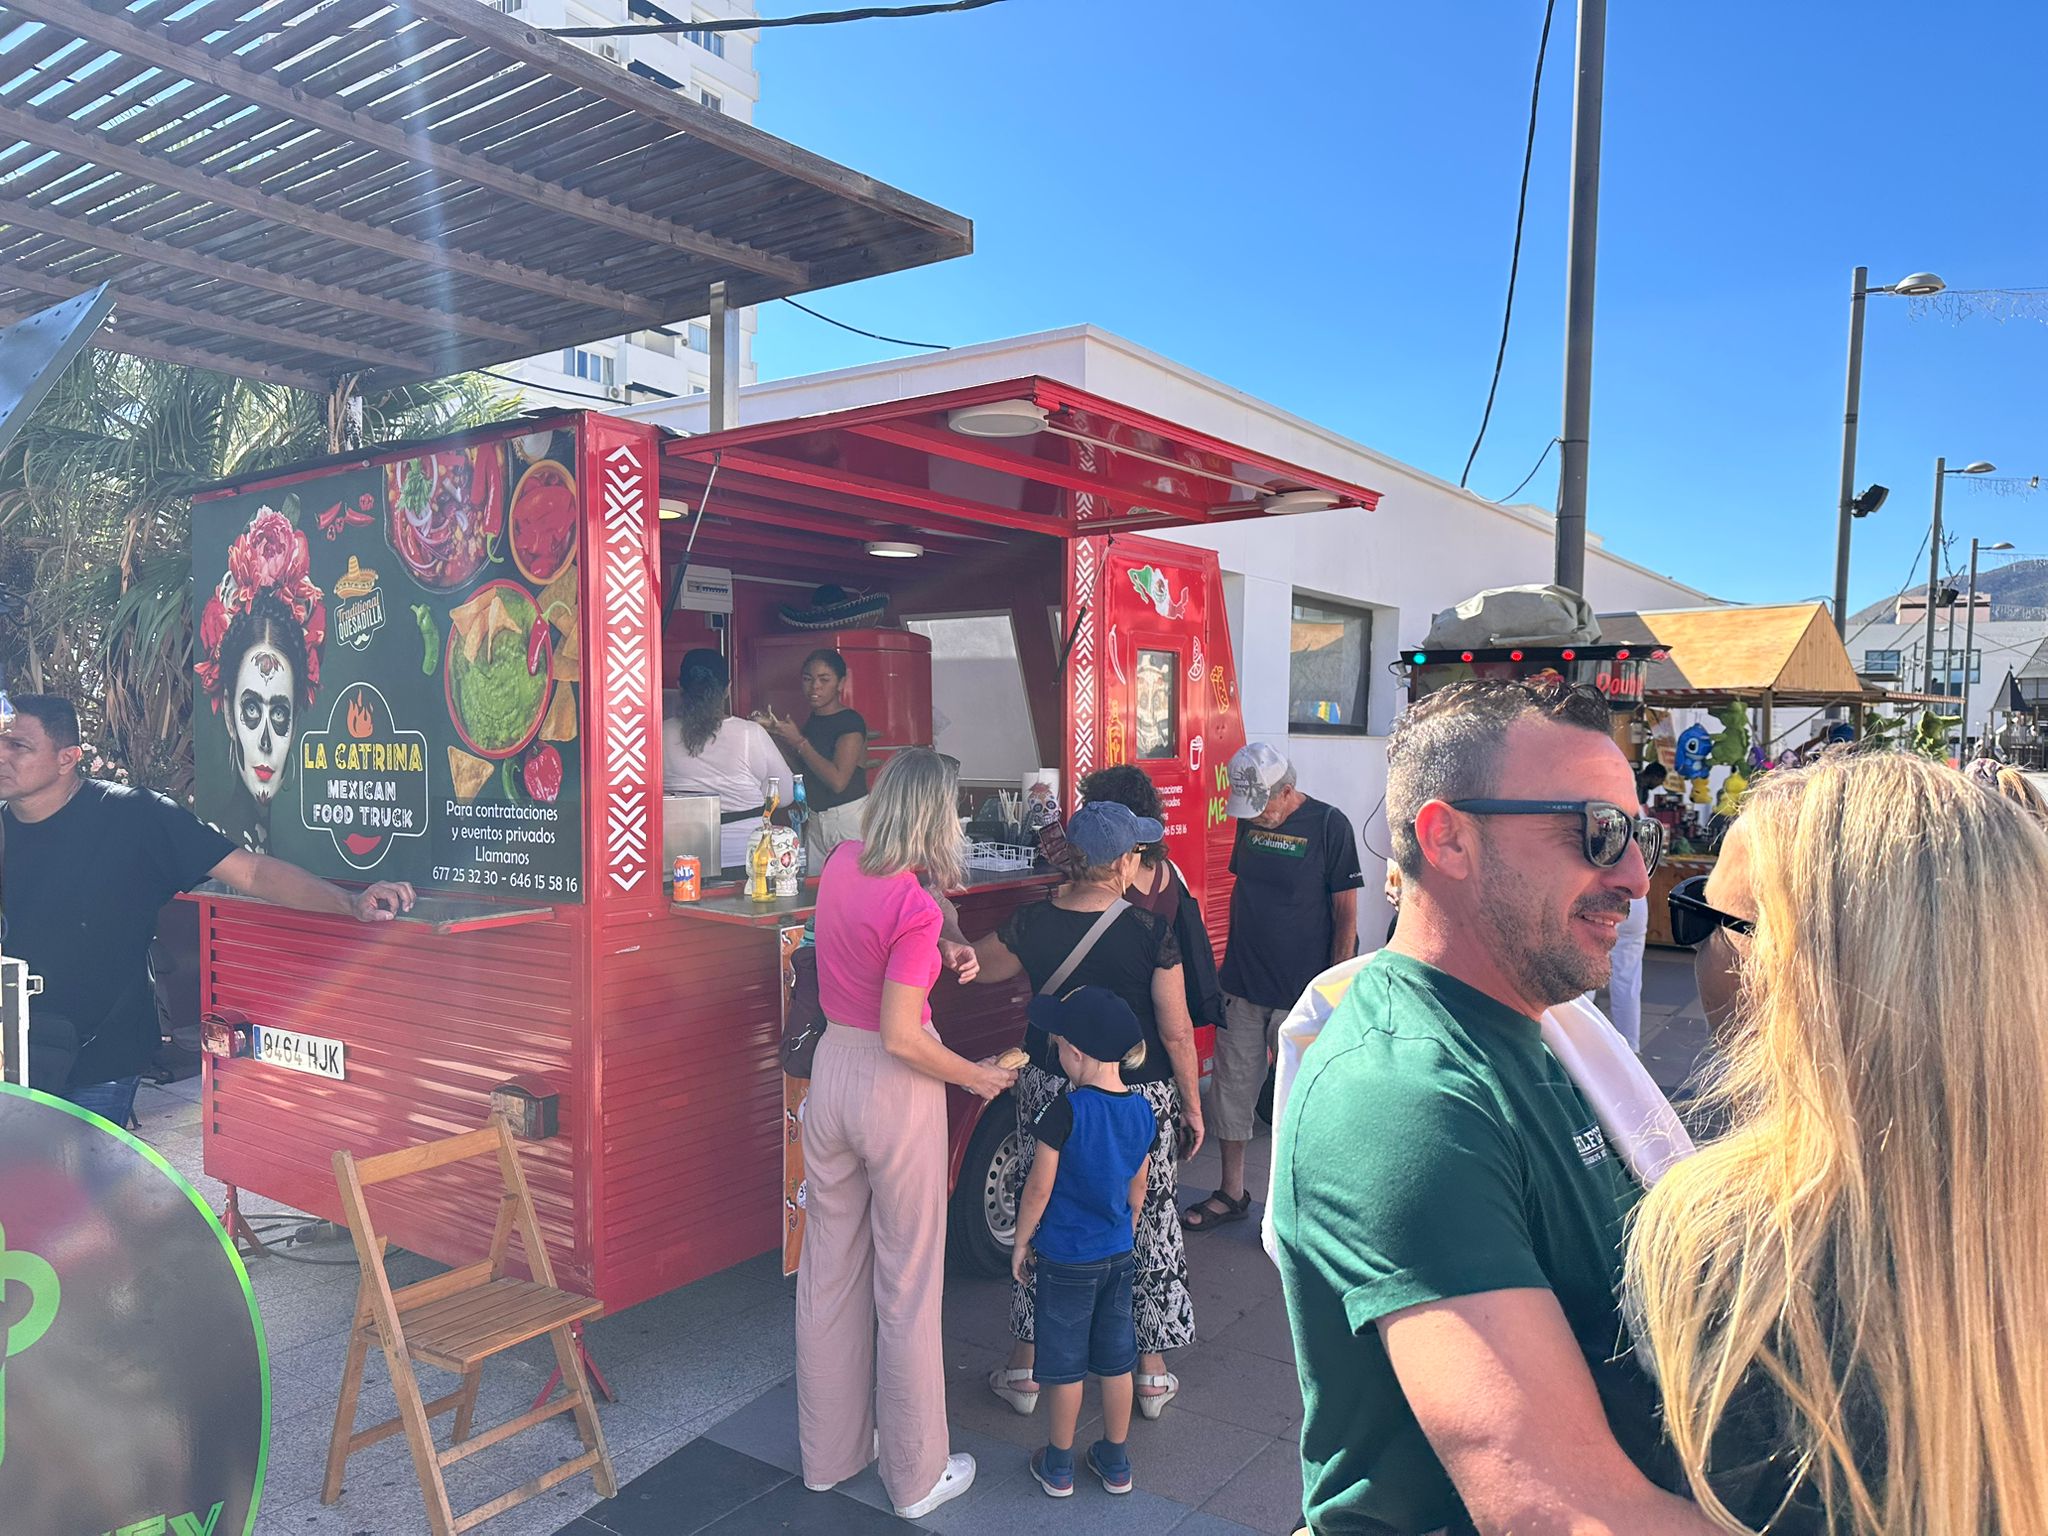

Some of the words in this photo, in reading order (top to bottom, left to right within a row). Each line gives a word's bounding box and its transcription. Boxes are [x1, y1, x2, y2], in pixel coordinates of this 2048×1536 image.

[336, 591, 380, 623] Traditional
[338, 604, 383, 641] QUESADILLA
[304, 743, 328, 769] LA
[335, 743, 423, 772] CATRINA
[327, 780, 396, 801] MEXICAN
[313, 804, 354, 824] FOOD
[359, 806, 413, 828] TRUCK
[446, 800, 473, 817] Para
[475, 803, 558, 821] contrataciones
[451, 826, 459, 840] y
[461, 825, 503, 841] eventos
[506, 827, 556, 844] privados
[1259, 835, 1296, 852] Columbia
[475, 846, 530, 865] Llamanos
[432, 866, 450, 880] 677
[452, 867, 465, 882] 25
[468, 869, 481, 884] 32
[483, 871, 498, 885] 30
[510, 873, 532, 888] 646
[535, 874, 545, 889] 15
[548, 876, 563, 891] 58
[565, 877, 578, 892] 16
[307, 1040, 339, 1074] HJK
